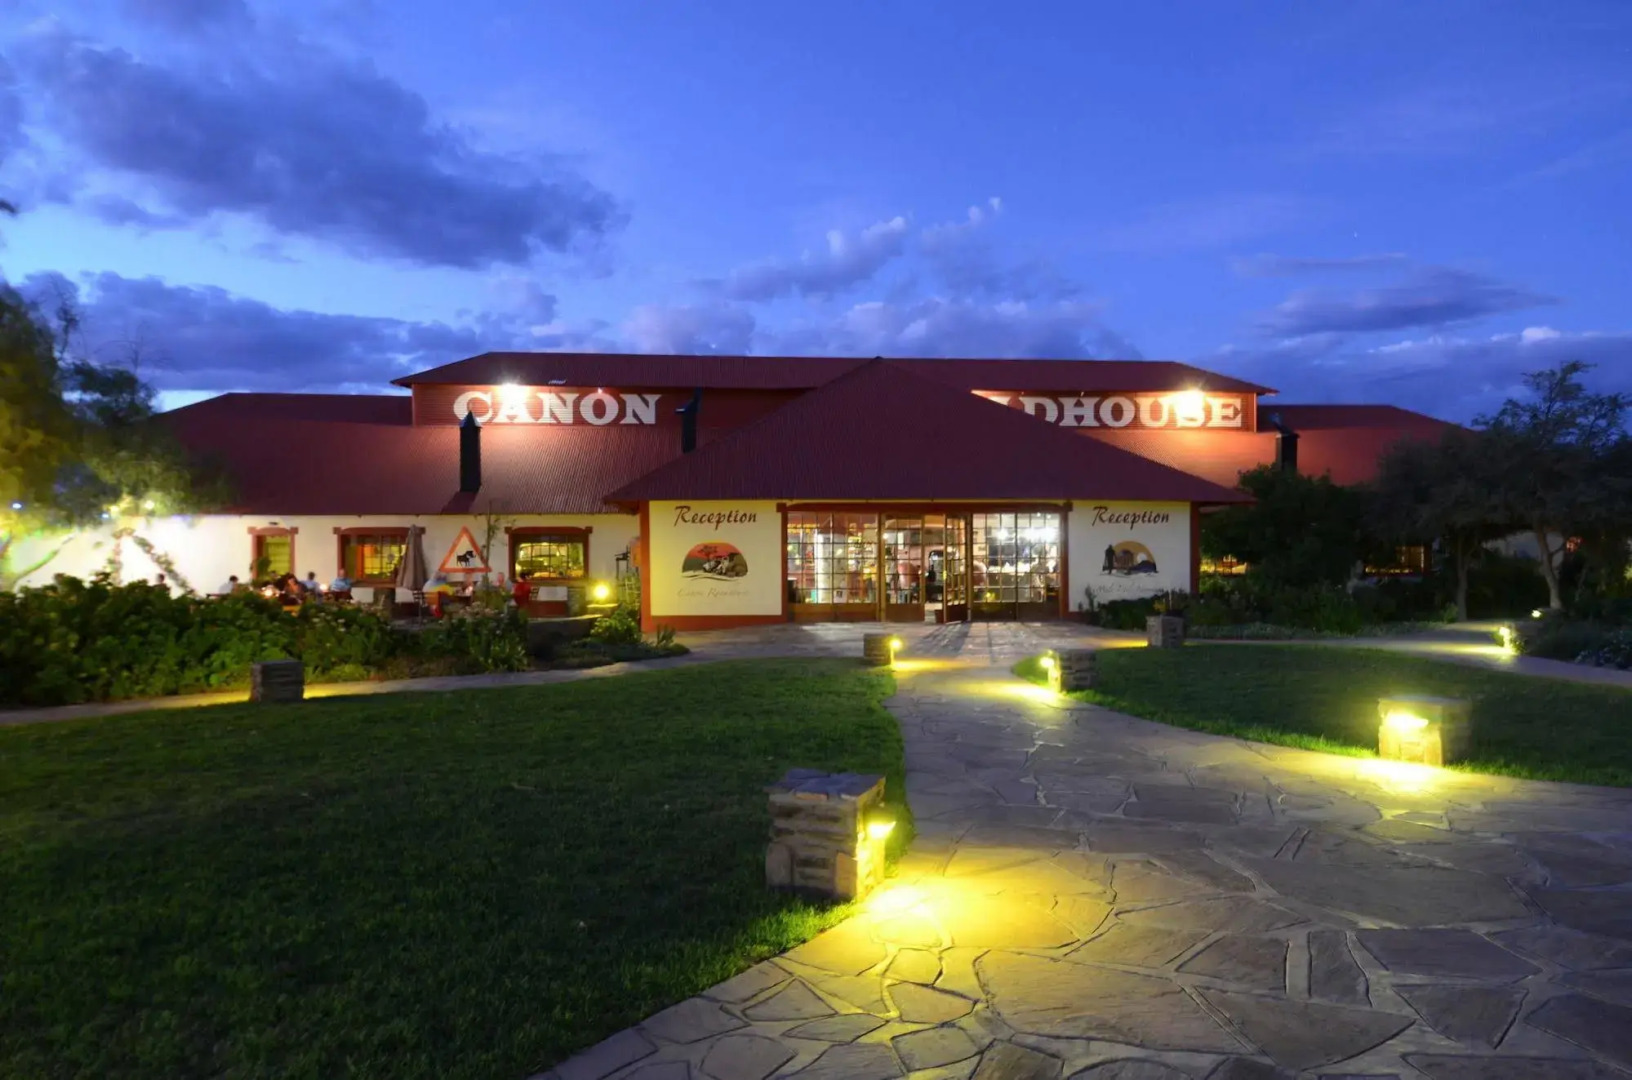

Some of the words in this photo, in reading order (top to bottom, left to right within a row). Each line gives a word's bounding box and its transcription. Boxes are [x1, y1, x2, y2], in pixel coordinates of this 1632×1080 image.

[453, 391, 662, 425] CANON
[987, 396, 1242, 428] DHOUSE
[674, 505, 757, 531] Reception
[1092, 506, 1169, 531] Reception
